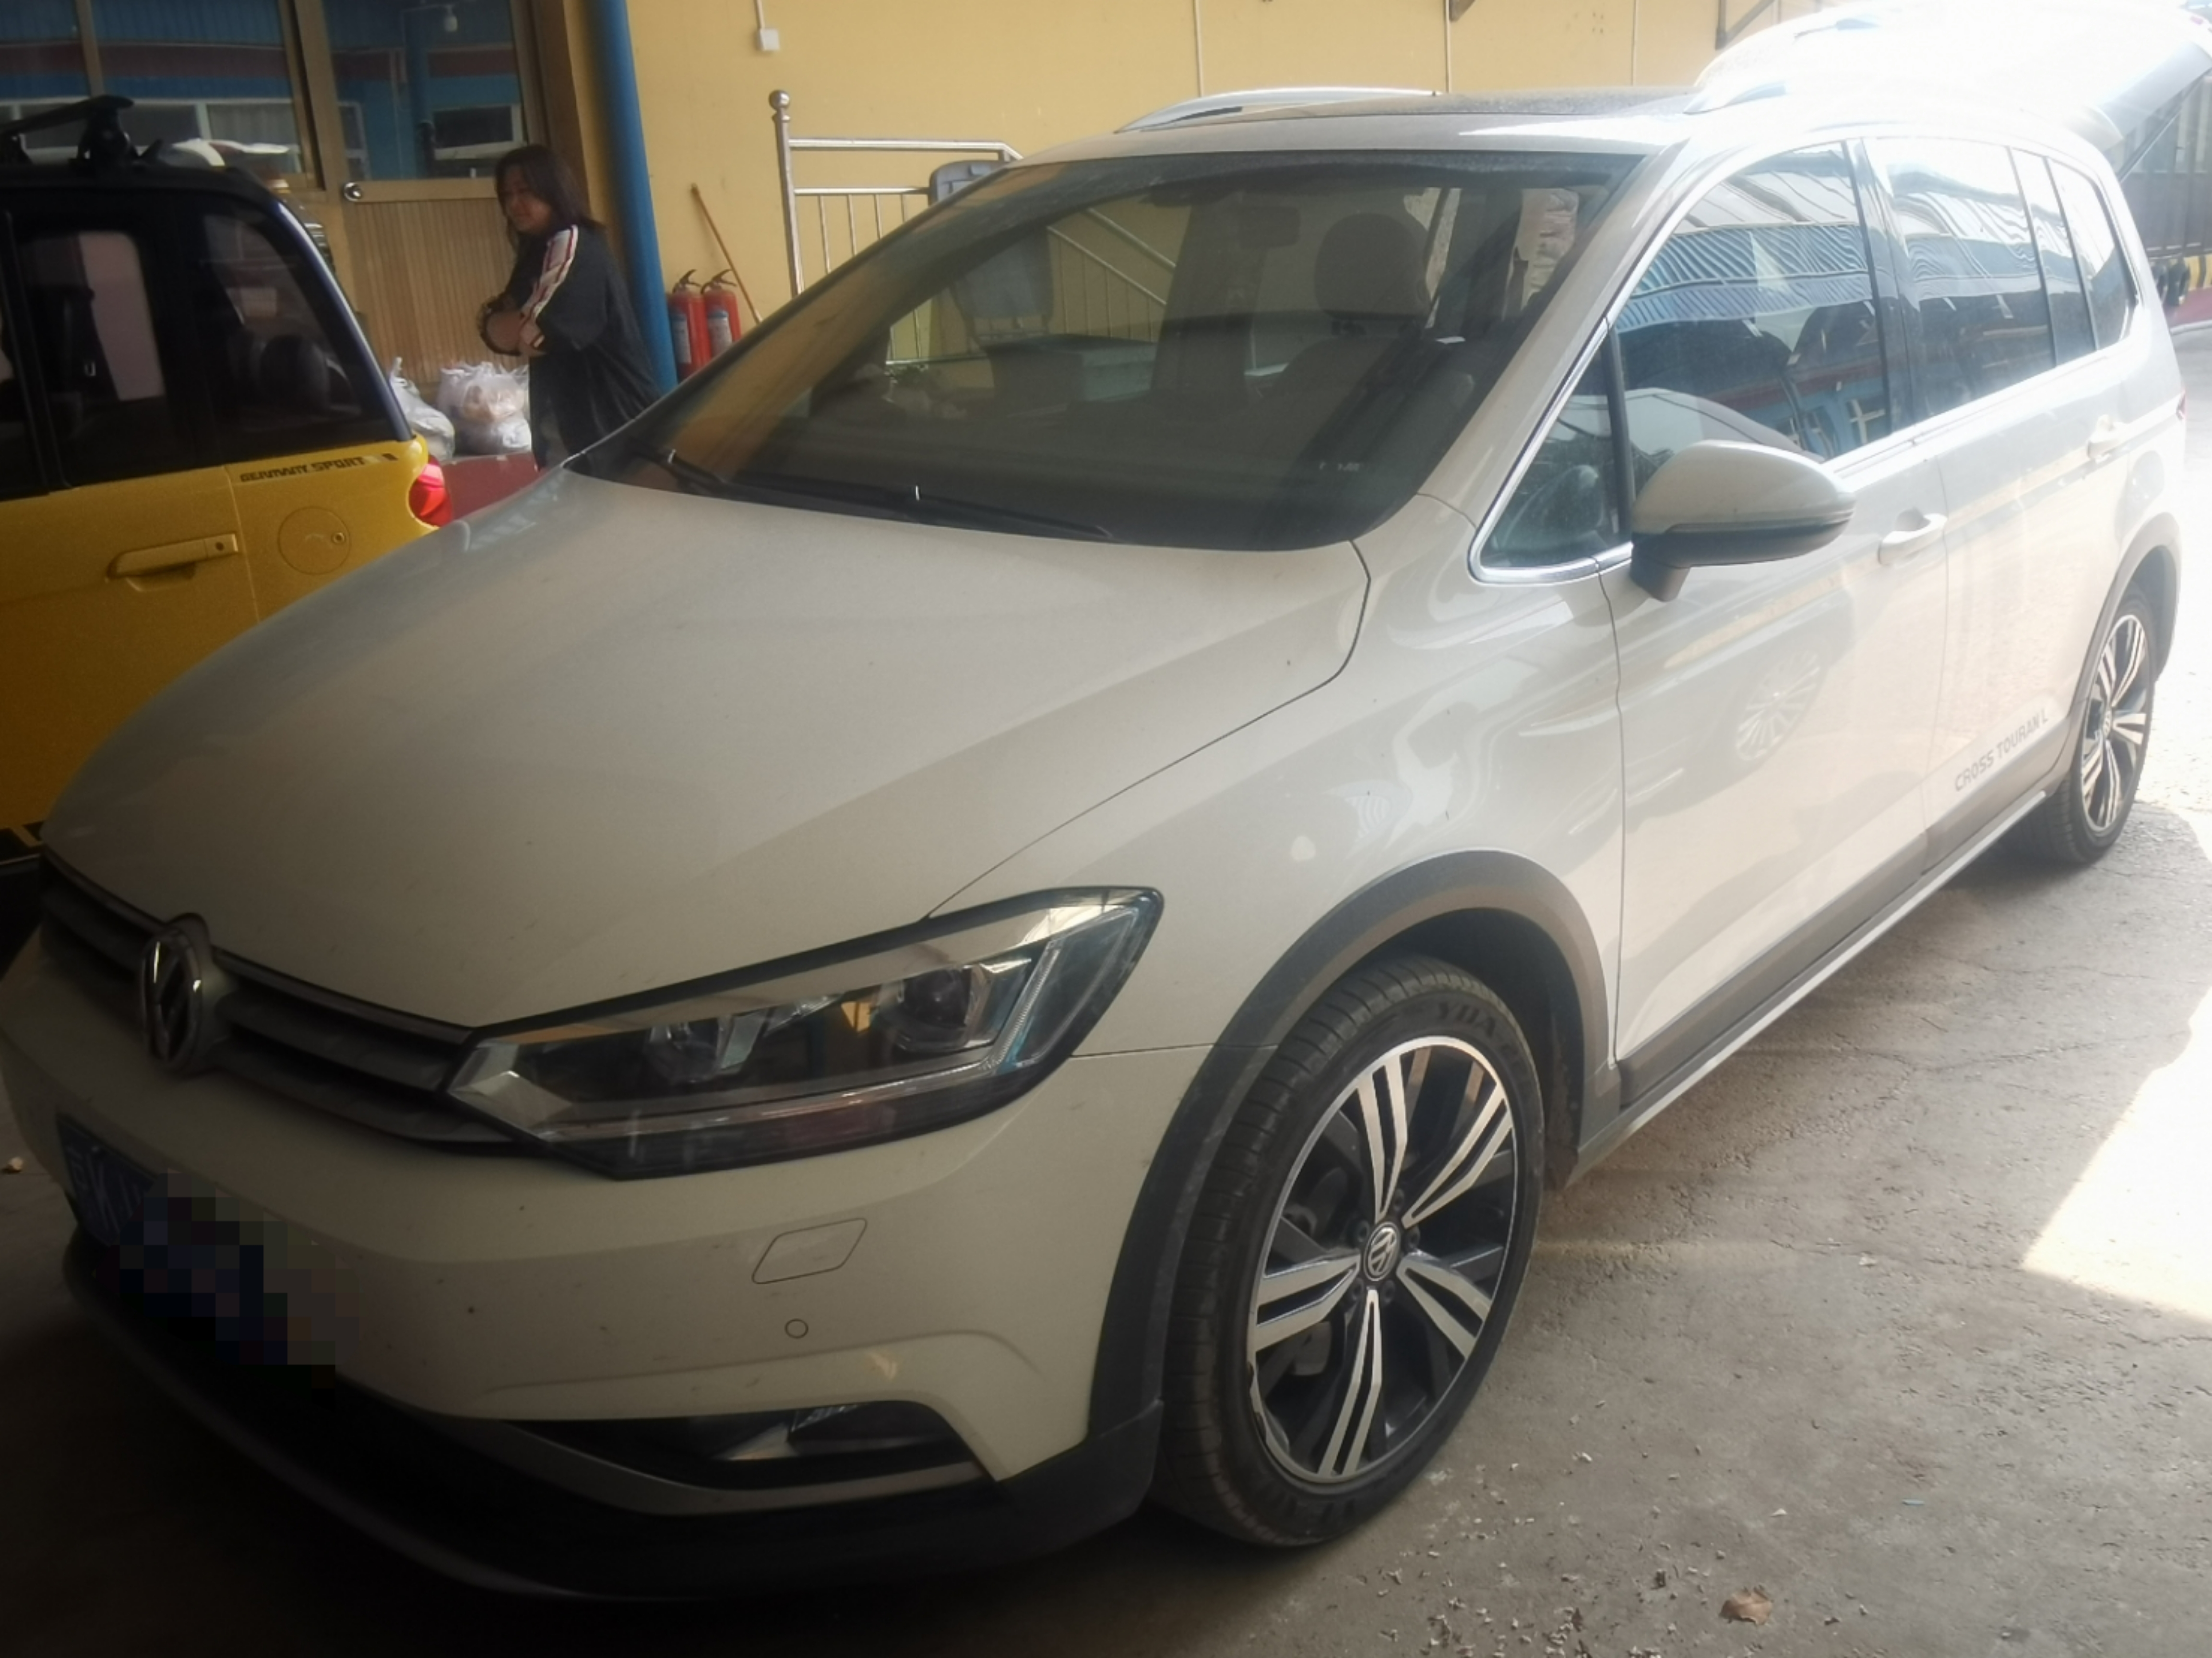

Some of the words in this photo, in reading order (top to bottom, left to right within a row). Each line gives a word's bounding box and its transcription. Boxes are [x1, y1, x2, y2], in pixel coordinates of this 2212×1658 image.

[240, 464, 308, 482] GERMANY
[311, 457, 365, 472] SPORT
[1955, 749, 1994, 792] CROSS
[1996, 712, 2039, 758] TOURAN
[2041, 708, 2048, 723] L
